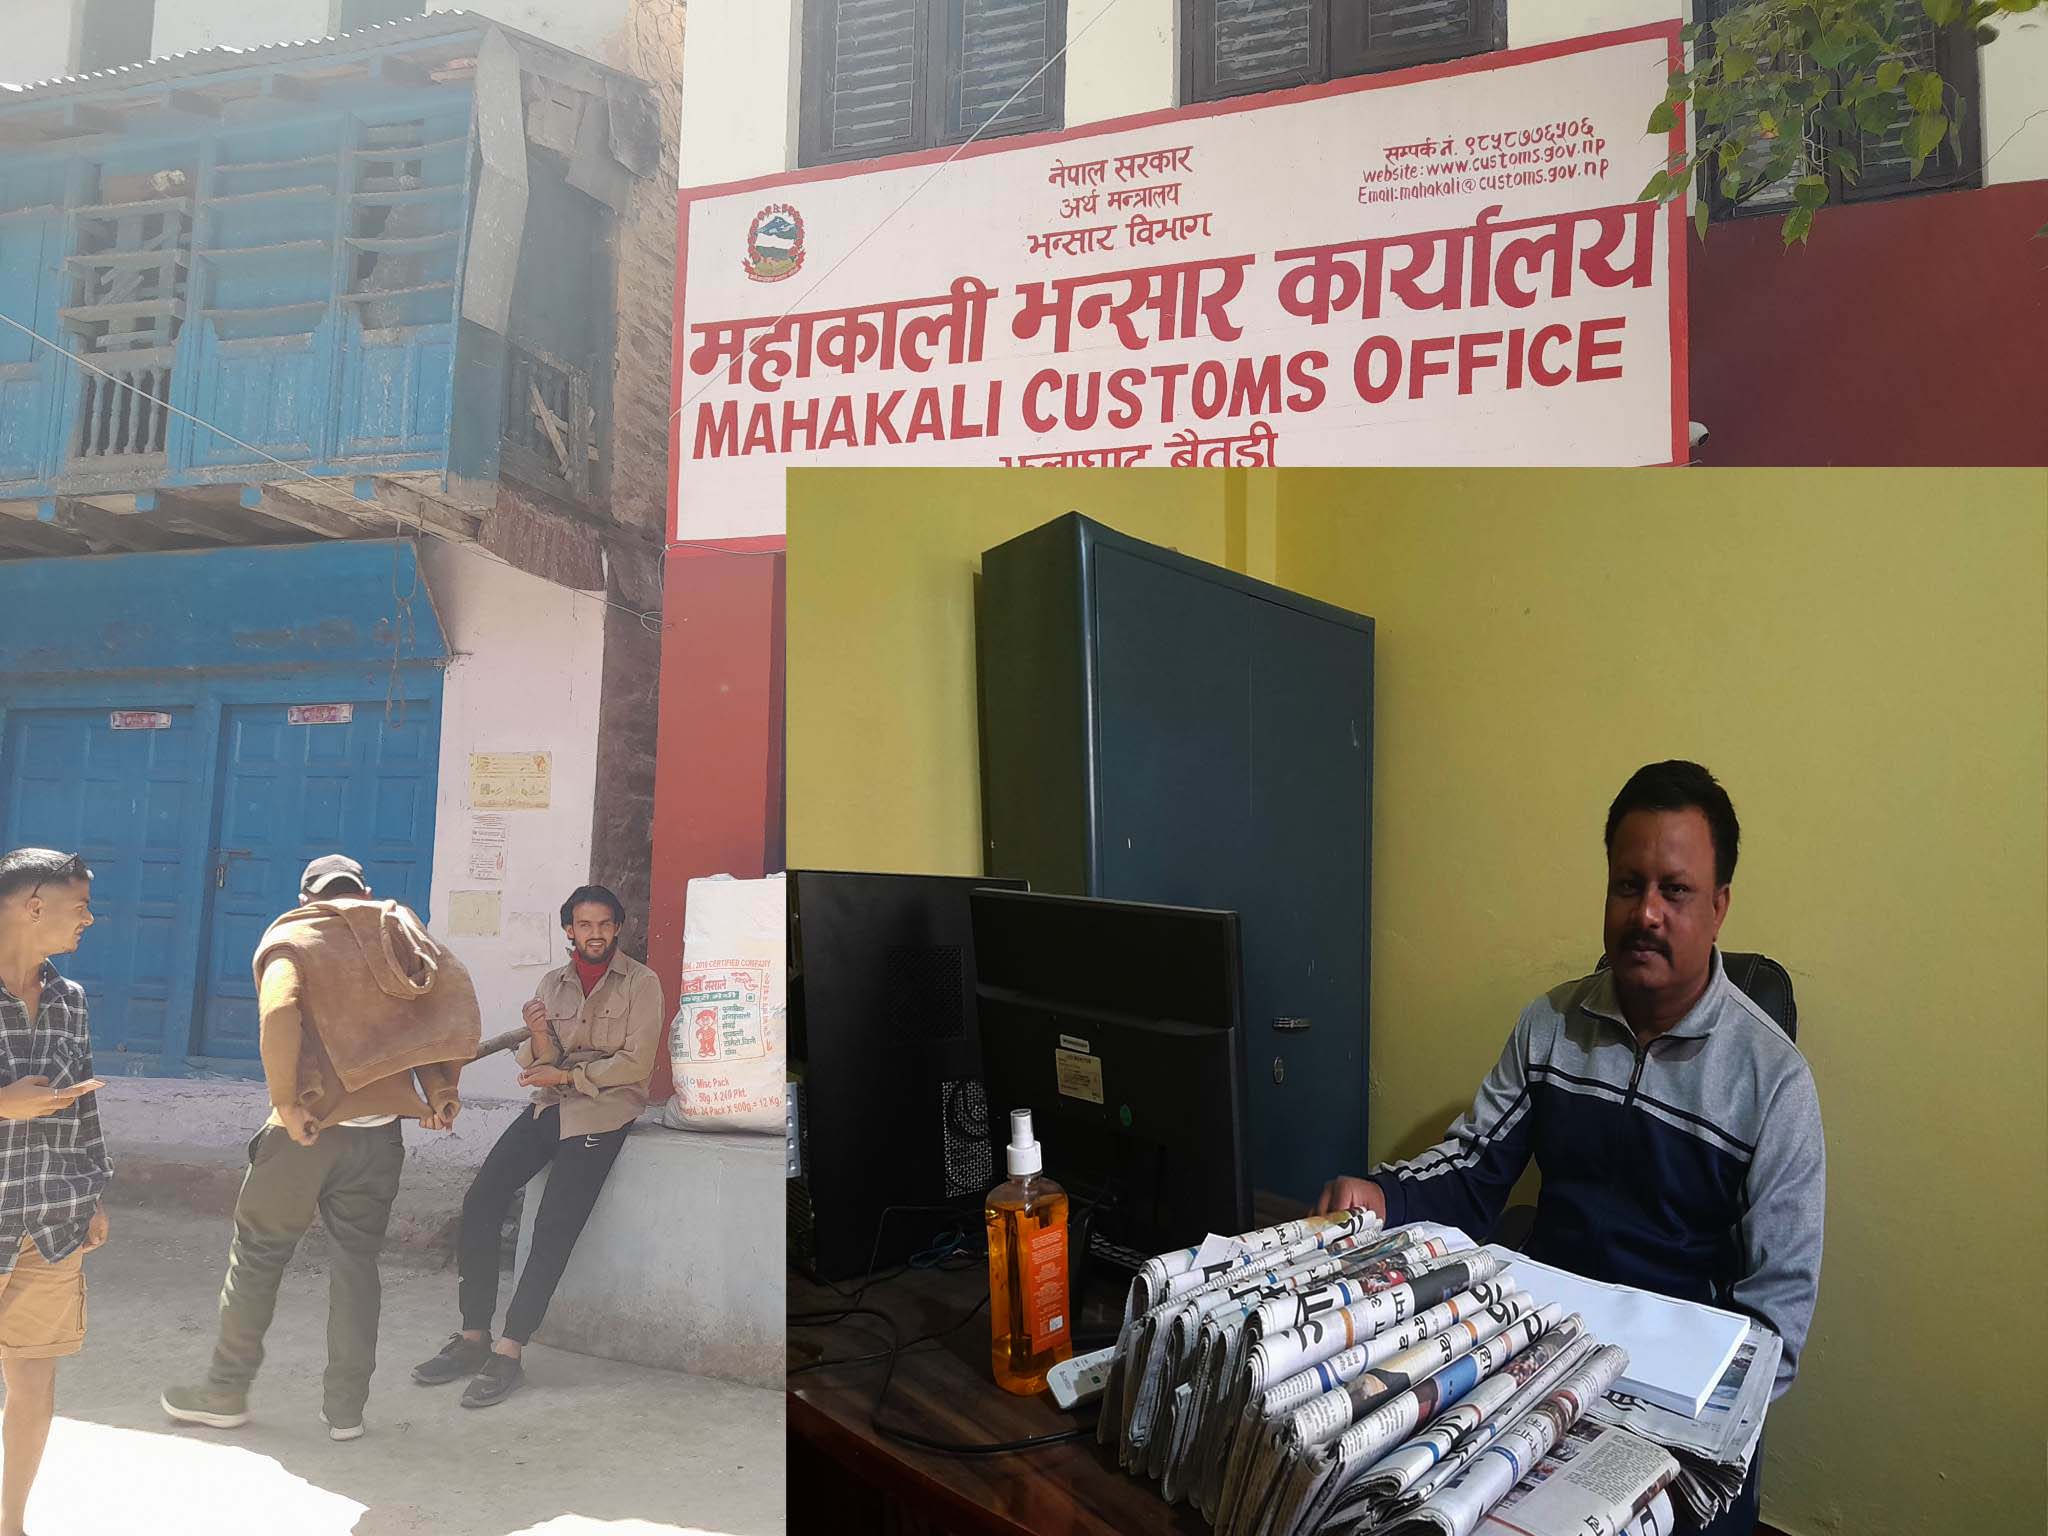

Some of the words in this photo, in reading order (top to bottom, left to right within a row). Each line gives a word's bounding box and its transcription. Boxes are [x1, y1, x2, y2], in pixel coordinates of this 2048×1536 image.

[1048, 159, 1109, 188] नेपाल
[1113, 145, 1194, 183] सरकार
[1383, 137, 1439, 165] सम्पर्क
[1060, 188, 1101, 219] अर्थ
[1107, 182, 1182, 210] मन्त्रालय
[1027, 225, 1118, 259] भन्सार
[1125, 213, 1213, 247] विभाग
[689, 276, 999, 392] महाकाली
[1012, 254, 1256, 353] भन्सार
[1274, 201, 1661, 325] कार्यालय
[692, 379, 1003, 460] MAHAKALI
[1021, 349, 1329, 434] CUSTOMS
[1353, 316, 1628, 405] OFFICE
